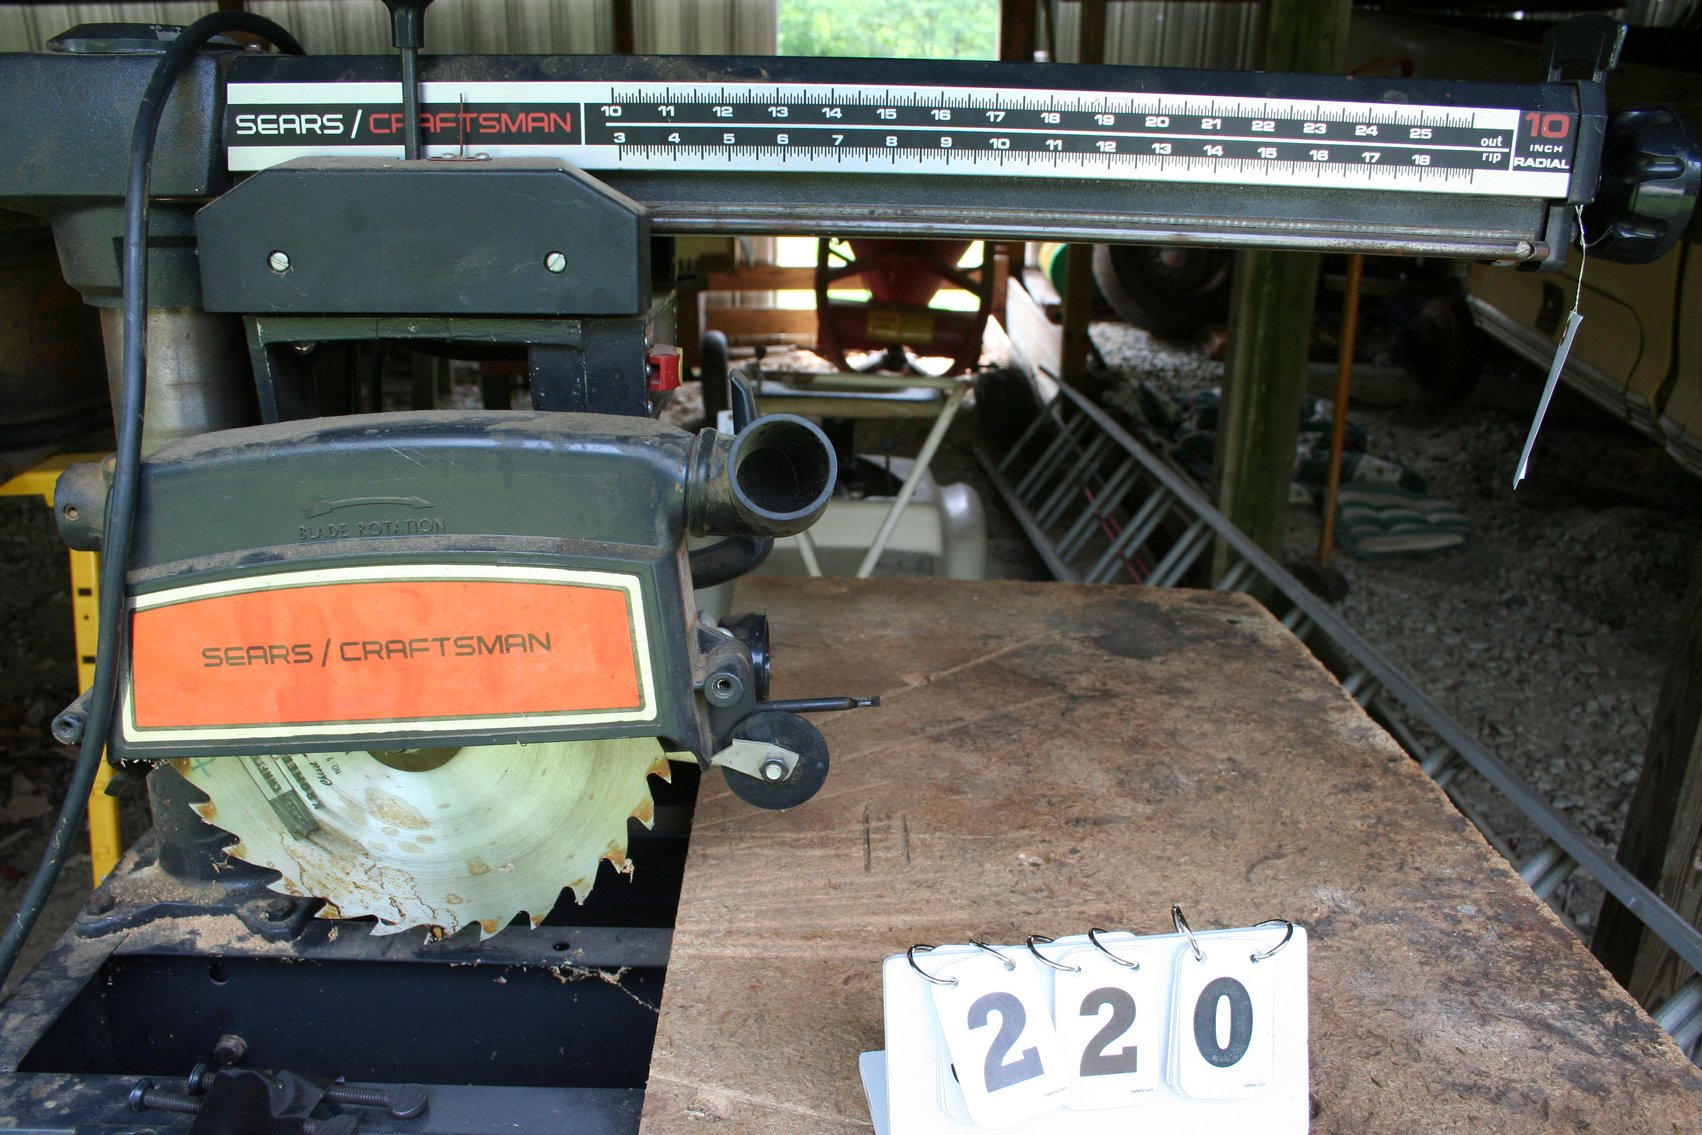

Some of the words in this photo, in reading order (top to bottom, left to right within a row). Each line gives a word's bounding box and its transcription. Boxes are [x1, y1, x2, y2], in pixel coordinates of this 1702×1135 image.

[235, 113, 345, 135] SEARS
[601, 106, 622, 116] 10
[658, 106, 674, 116] 11
[713, 106, 733, 117] 12
[768, 106, 788, 117] 13
[822, 107, 842, 118] 14
[876, 108, 897, 119] 15
[931, 109, 951, 120] 16
[986, 111, 1005, 122] 17
[1040, 112, 1060, 124] 18
[1094, 114, 1115, 125] 19
[1145, 116, 1169, 127] 20
[1201, 118, 1221, 129] 21
[1251, 120, 1275, 132] 22
[1303, 122, 1327, 134] 23
[1355, 125, 1378, 136] 24
[1409, 128, 1432, 139] 25
[1481, 136, 1502, 147] out
[1525, 111, 1570, 138] 10
[614, 132, 625, 143] 3
[668, 133, 680, 143] 4
[723, 133, 735, 144] 5
[777, 134, 789, 144] 6
[832, 135, 843, 145] 7
[886, 136, 897, 146] 8
[940, 137, 952, 147] 9
[989, 138, 1010, 149] 10
[1046, 139, 1062, 150] 11
[1096, 141, 1116, 152] 12
[1152, 143, 1172, 154] 13
[1203, 145, 1223, 156] 14
[1257, 147, 1277, 158] 15
[1309, 150, 1329, 161] 16
[1362, 152, 1381, 163] 17
[1412, 154, 1430, 165] 18
[1482, 153, 1501, 163] rip
[1529, 144, 1563, 153] INCH
[1513, 156, 1570, 169] RADIAL
[299, 522, 349, 541] BLADE
[357, 516, 447, 538] ROTATION
[202, 643, 313, 667] SEARS
[339, 631, 552, 662] CRAFTSMAN
